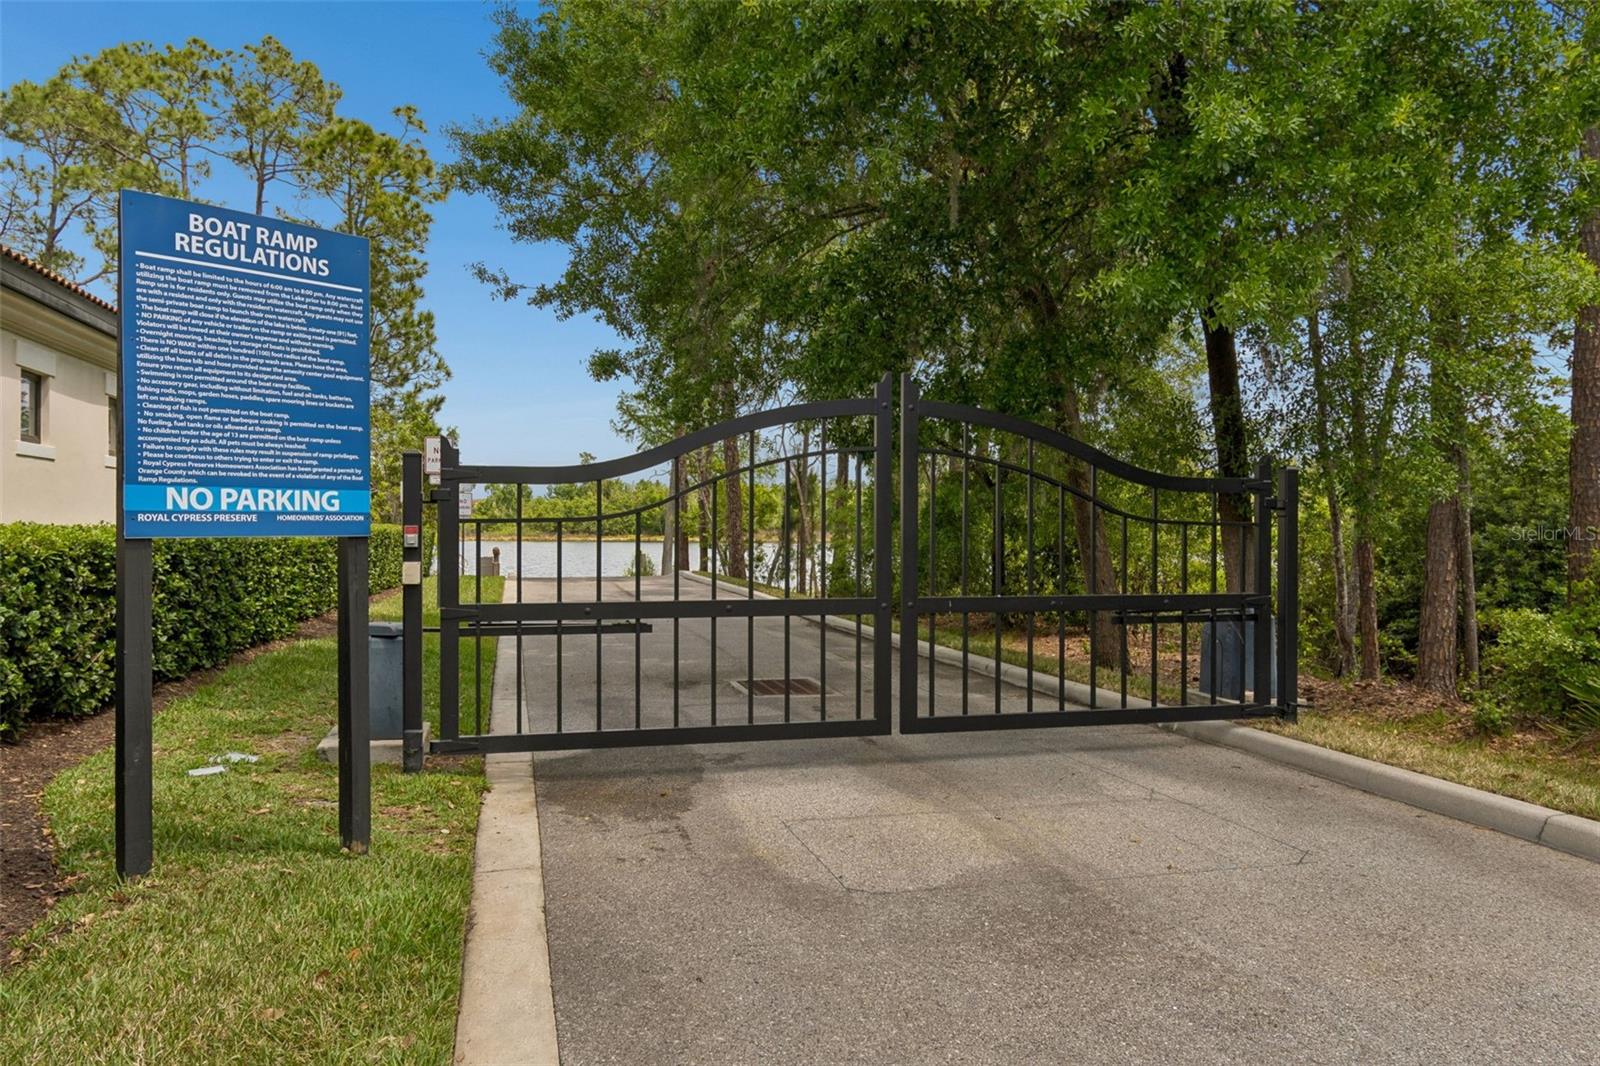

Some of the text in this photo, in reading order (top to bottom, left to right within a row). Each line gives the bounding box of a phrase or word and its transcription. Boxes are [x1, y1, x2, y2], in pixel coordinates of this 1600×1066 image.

[189, 214, 318, 254] BOAT RAMP
[175, 233, 330, 276] REGULATIONS
[136, 272, 164, 281] utilizing
[203, 273, 225, 281] limited
[136, 278, 156, 288] Ramp
[136, 320, 165, 328] Violators
[140, 328, 173, 338] Overnight
[204, 336, 232, 346] beaching
[142, 403, 171, 411] Cleaning
[166, 487, 340, 511] NO PARKING
[138, 514, 169, 522] ROYAL
[171, 514, 212, 522] CYPRESS
[214, 514, 257, 522] PRESERVE
